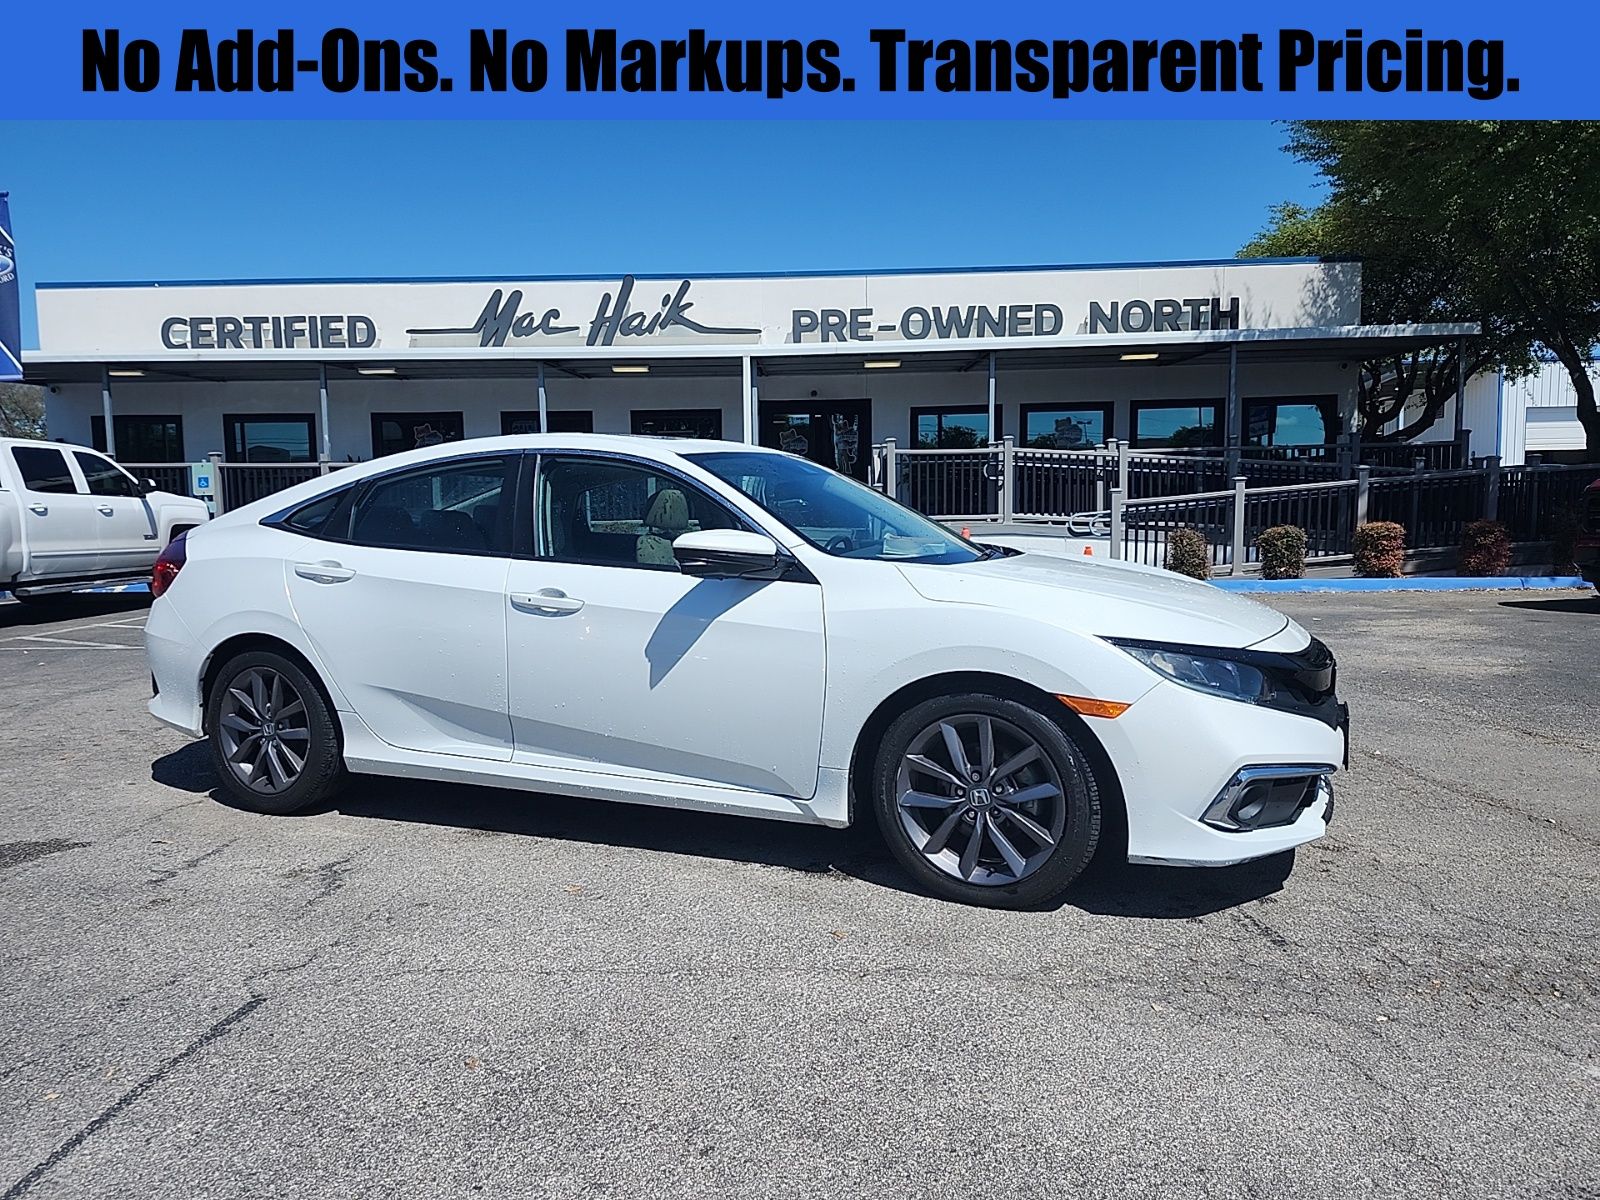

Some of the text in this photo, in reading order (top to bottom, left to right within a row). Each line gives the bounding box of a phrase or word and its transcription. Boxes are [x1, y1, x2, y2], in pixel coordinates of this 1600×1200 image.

[161, 316, 376, 348] CERTIFIED
[406, 275, 762, 347] Mac Haik
[793, 297, 1239, 343] PRE-OWNED NORTH
